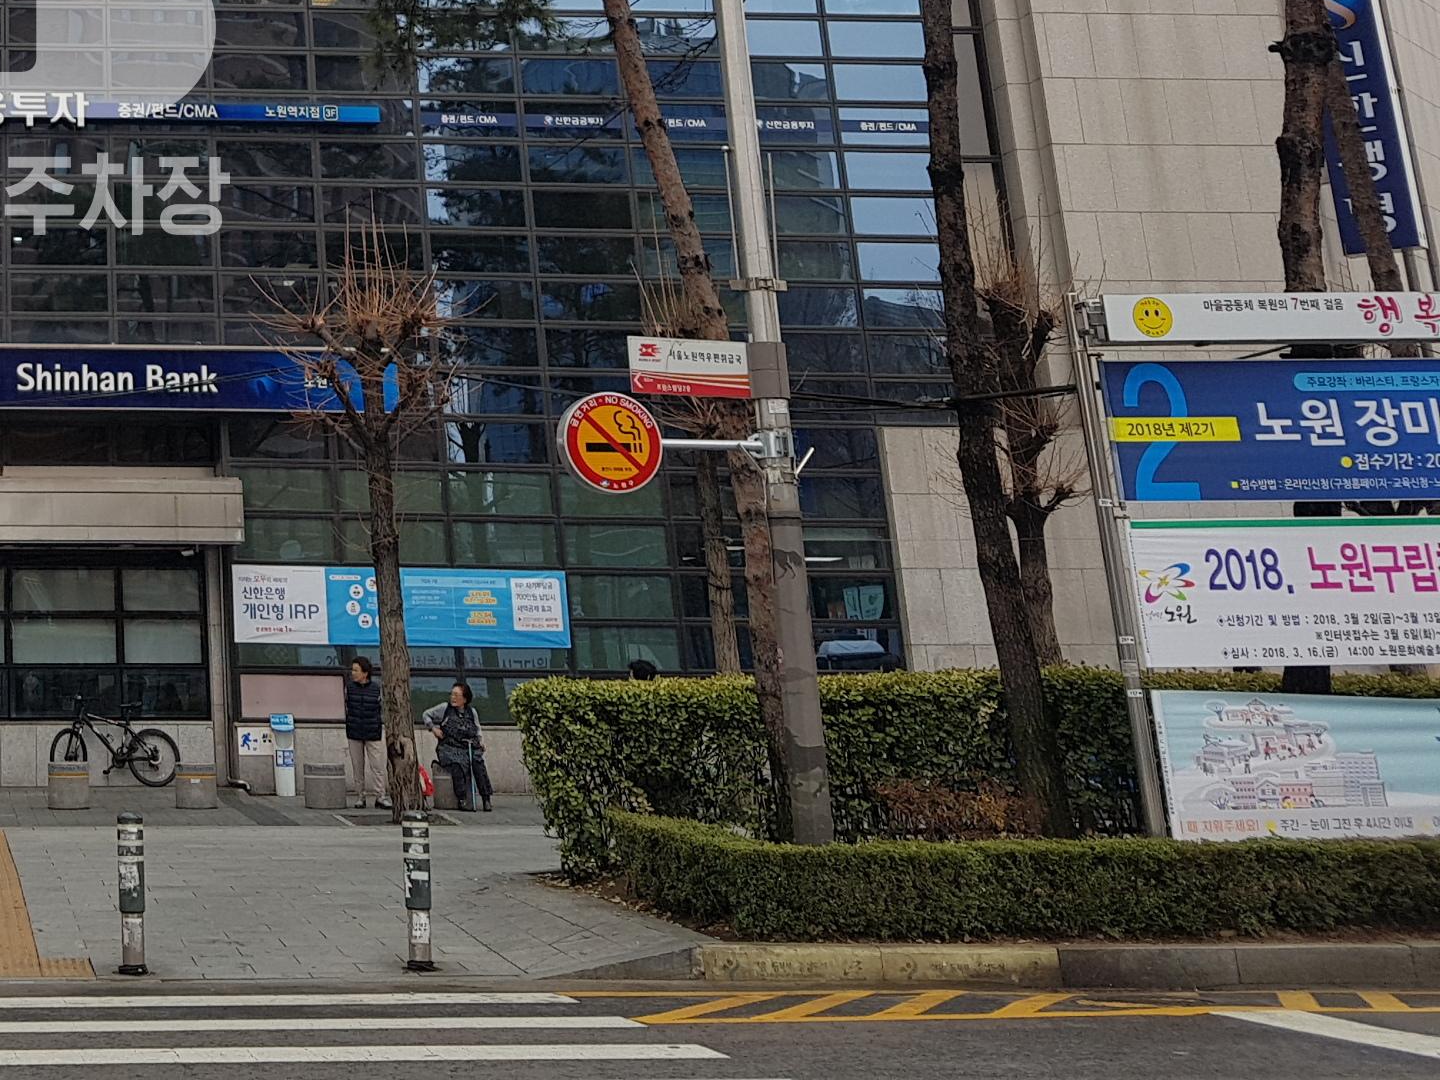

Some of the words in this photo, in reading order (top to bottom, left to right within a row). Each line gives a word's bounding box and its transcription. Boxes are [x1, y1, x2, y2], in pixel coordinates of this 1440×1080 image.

[117, 102, 219, 119] 증권/펀드/CMA
[264, 105, 321, 118] 노원역지점
[1203, 298, 1254, 312] 마을공동체
[1257, 298, 1288, 311] 복원의
[1290, 297, 1320, 311] 7번째
[1323, 298, 1344, 312] 걸음
[16, 362, 134, 393] Shinhan
[146, 363, 219, 393] Bank
[569, 398, 598, 428] 금연거리
[604, 395, 618, 405] NO
[619, 398, 654, 430] SMOKING
[1127, 422, 1177, 437] 2018년
[1180, 422, 1216, 437] 제2기
[1255, 399, 1347, 447] 노원
[1355, 453, 1415, 471] 접수기간
[1240, 479, 1277, 491] 접수방법
[1204, 547, 1295, 594] 2018.
[1306, 542, 1440, 594] 노원구립
[241, 585, 286, 601] 신한은행
[242, 603, 286, 621] 개인형
[289, 603, 320, 620] IRP
[1164, 604, 1198, 624] 노원
[1227, 613, 1269, 627] 신청기간
[1281, 613, 1301, 626] 방법
[1344, 612, 1359, 626] 3월
[1384, 628, 1400, 641] 3월
[1230, 647, 1250, 659] 심사
[1347, 646, 1375, 657] 14:00
[1280, 819, 1300, 832] 주간
[1310, 818, 1330, 831] 눈이
[1366, 817, 1392, 830] 4시간
